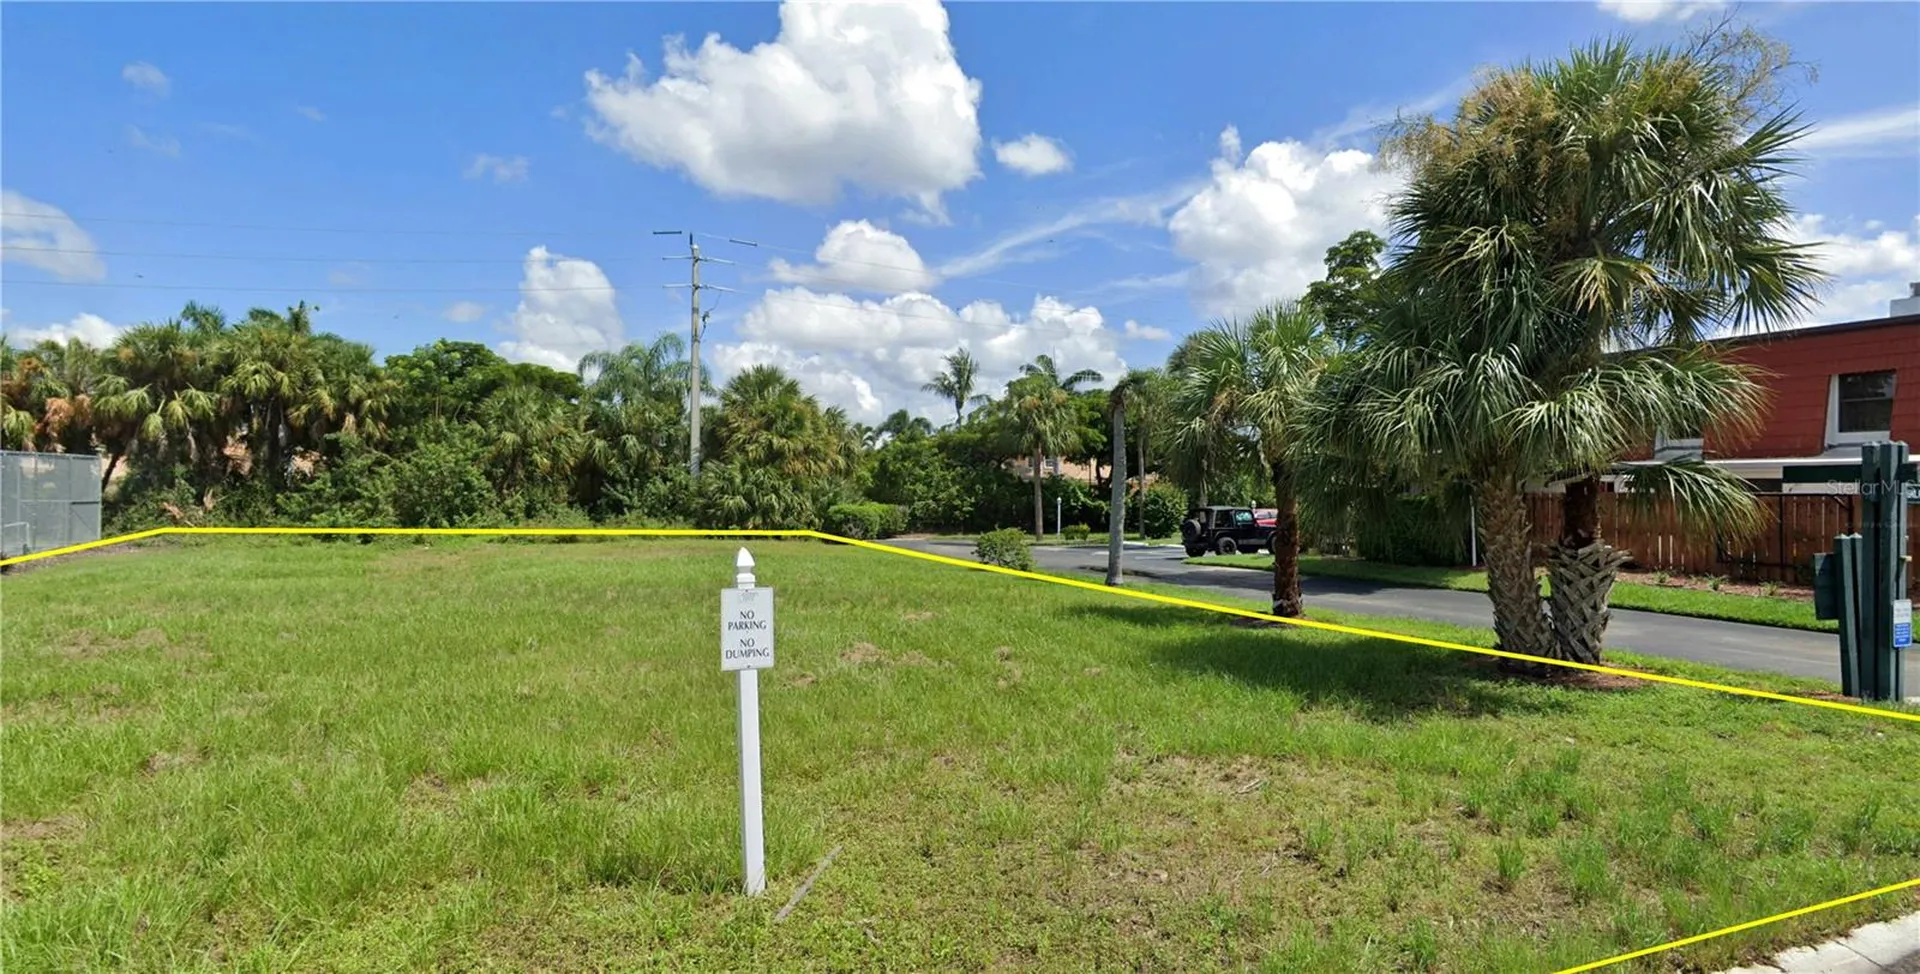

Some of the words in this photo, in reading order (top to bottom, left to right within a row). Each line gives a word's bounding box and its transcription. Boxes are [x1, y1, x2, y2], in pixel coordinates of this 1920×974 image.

[740, 610, 755, 620] NO
[727, 620, 767, 631] PARKING
[740, 638, 755, 648] NO
[725, 647, 770, 659] DUMPING
